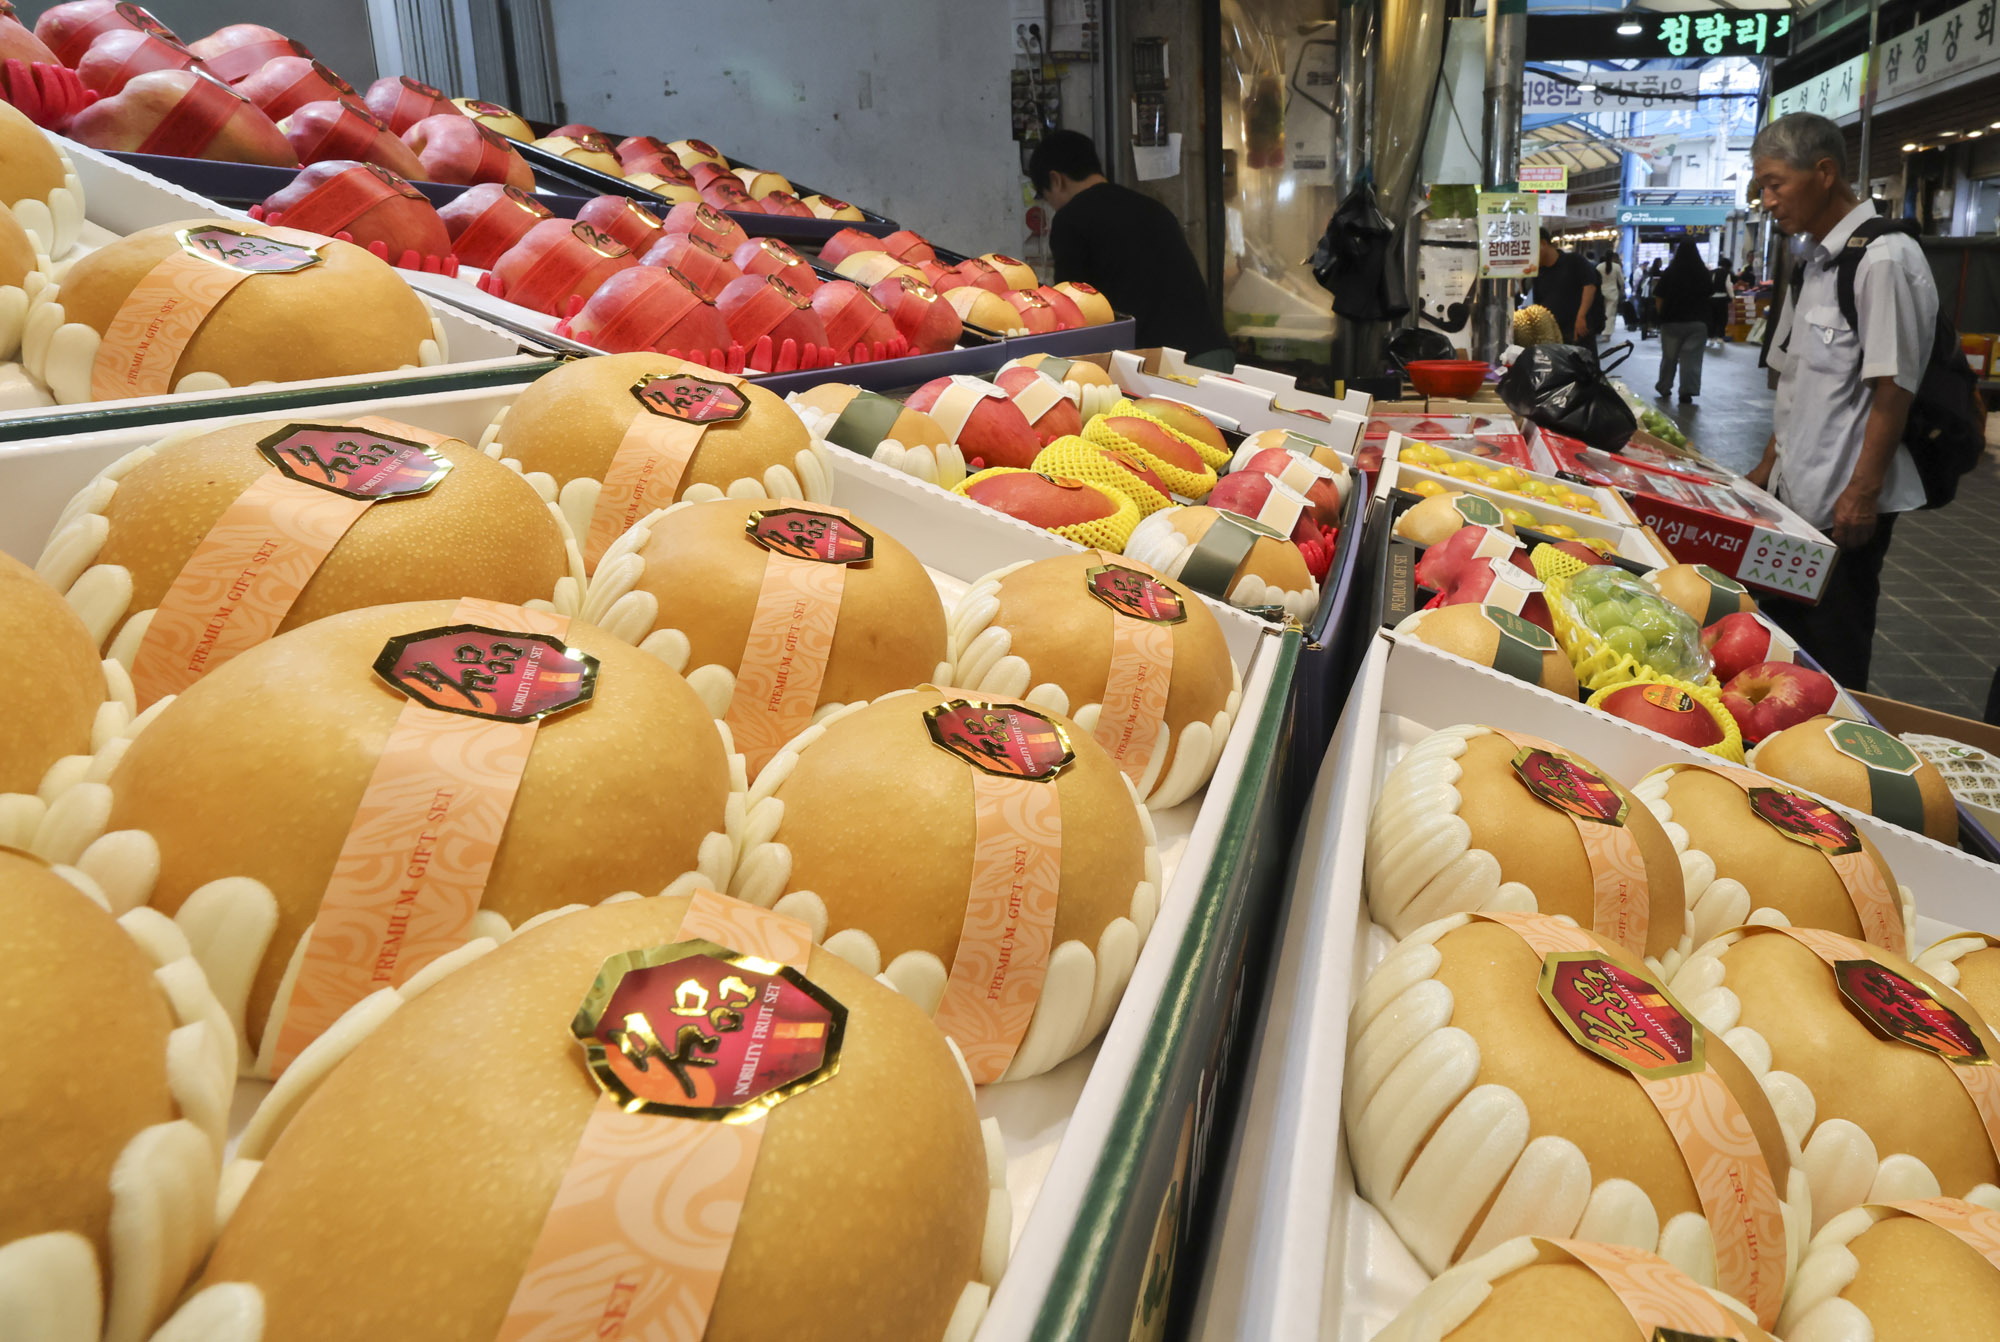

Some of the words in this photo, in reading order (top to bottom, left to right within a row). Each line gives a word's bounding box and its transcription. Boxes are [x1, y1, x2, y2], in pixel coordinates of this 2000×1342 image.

[1885, 0, 1997, 85] 삼정상회
[1488, 240, 1531, 257] 참여점포
[145, 317, 164, 339] GIFT
[160, 297, 178, 313] SET
[357, 470, 388, 493] NOBILITY
[386, 458, 404, 473] FRUIT
[400, 449, 415, 461] SET
[633, 478, 648, 500] GIFT
[643, 457, 656, 474] SET
[1699, 530, 1743, 552] 사과
[227, 568, 257, 601] GIFT
[252, 539, 278, 564] SET
[1393, 565, 1408, 578] GIFT
[1394, 554, 1408, 564] SET
[1391, 579, 1407, 612] PREMIUM
[784, 625, 800, 652] GIFT
[792, 600, 807, 620] SET
[510, 680, 530, 713] NOBILITY
[523, 660, 538, 681] FRUIT
[532, 645, 544, 659] SET
[1137, 664, 1147, 682] SET
[1132, 686, 1145, 710] GIFT
[1008, 713, 1019, 726] SET
[1014, 726, 1026, 748] FRUIT
[1020, 747, 1038, 773] NOBILITY
[1562, 762, 1575, 775] SET
[1573, 774, 1588, 791] FRUIT
[1586, 791, 1610, 817] NOBILITY
[407, 831, 440, 882] GIFT
[433, 788, 455, 824] SET
[1014, 846, 1028, 875] SET
[1007, 881, 1024, 920] GIFT
[1599, 965, 1620, 982] SET
[1878, 972, 1898, 988] SET
[763, 982, 782, 1004] SET
[1616, 983, 1644, 1010] FRUIT
[1896, 987, 1926, 1011] FRUIT
[753, 1004, 774, 1046] FRUIT
[1641, 1011, 1686, 1054] NOBILITY
[1926, 1012, 1973, 1050] NOBILITY
[732, 1043, 763, 1096] NOBILITY
[600, 1277, 638, 1340] SET
